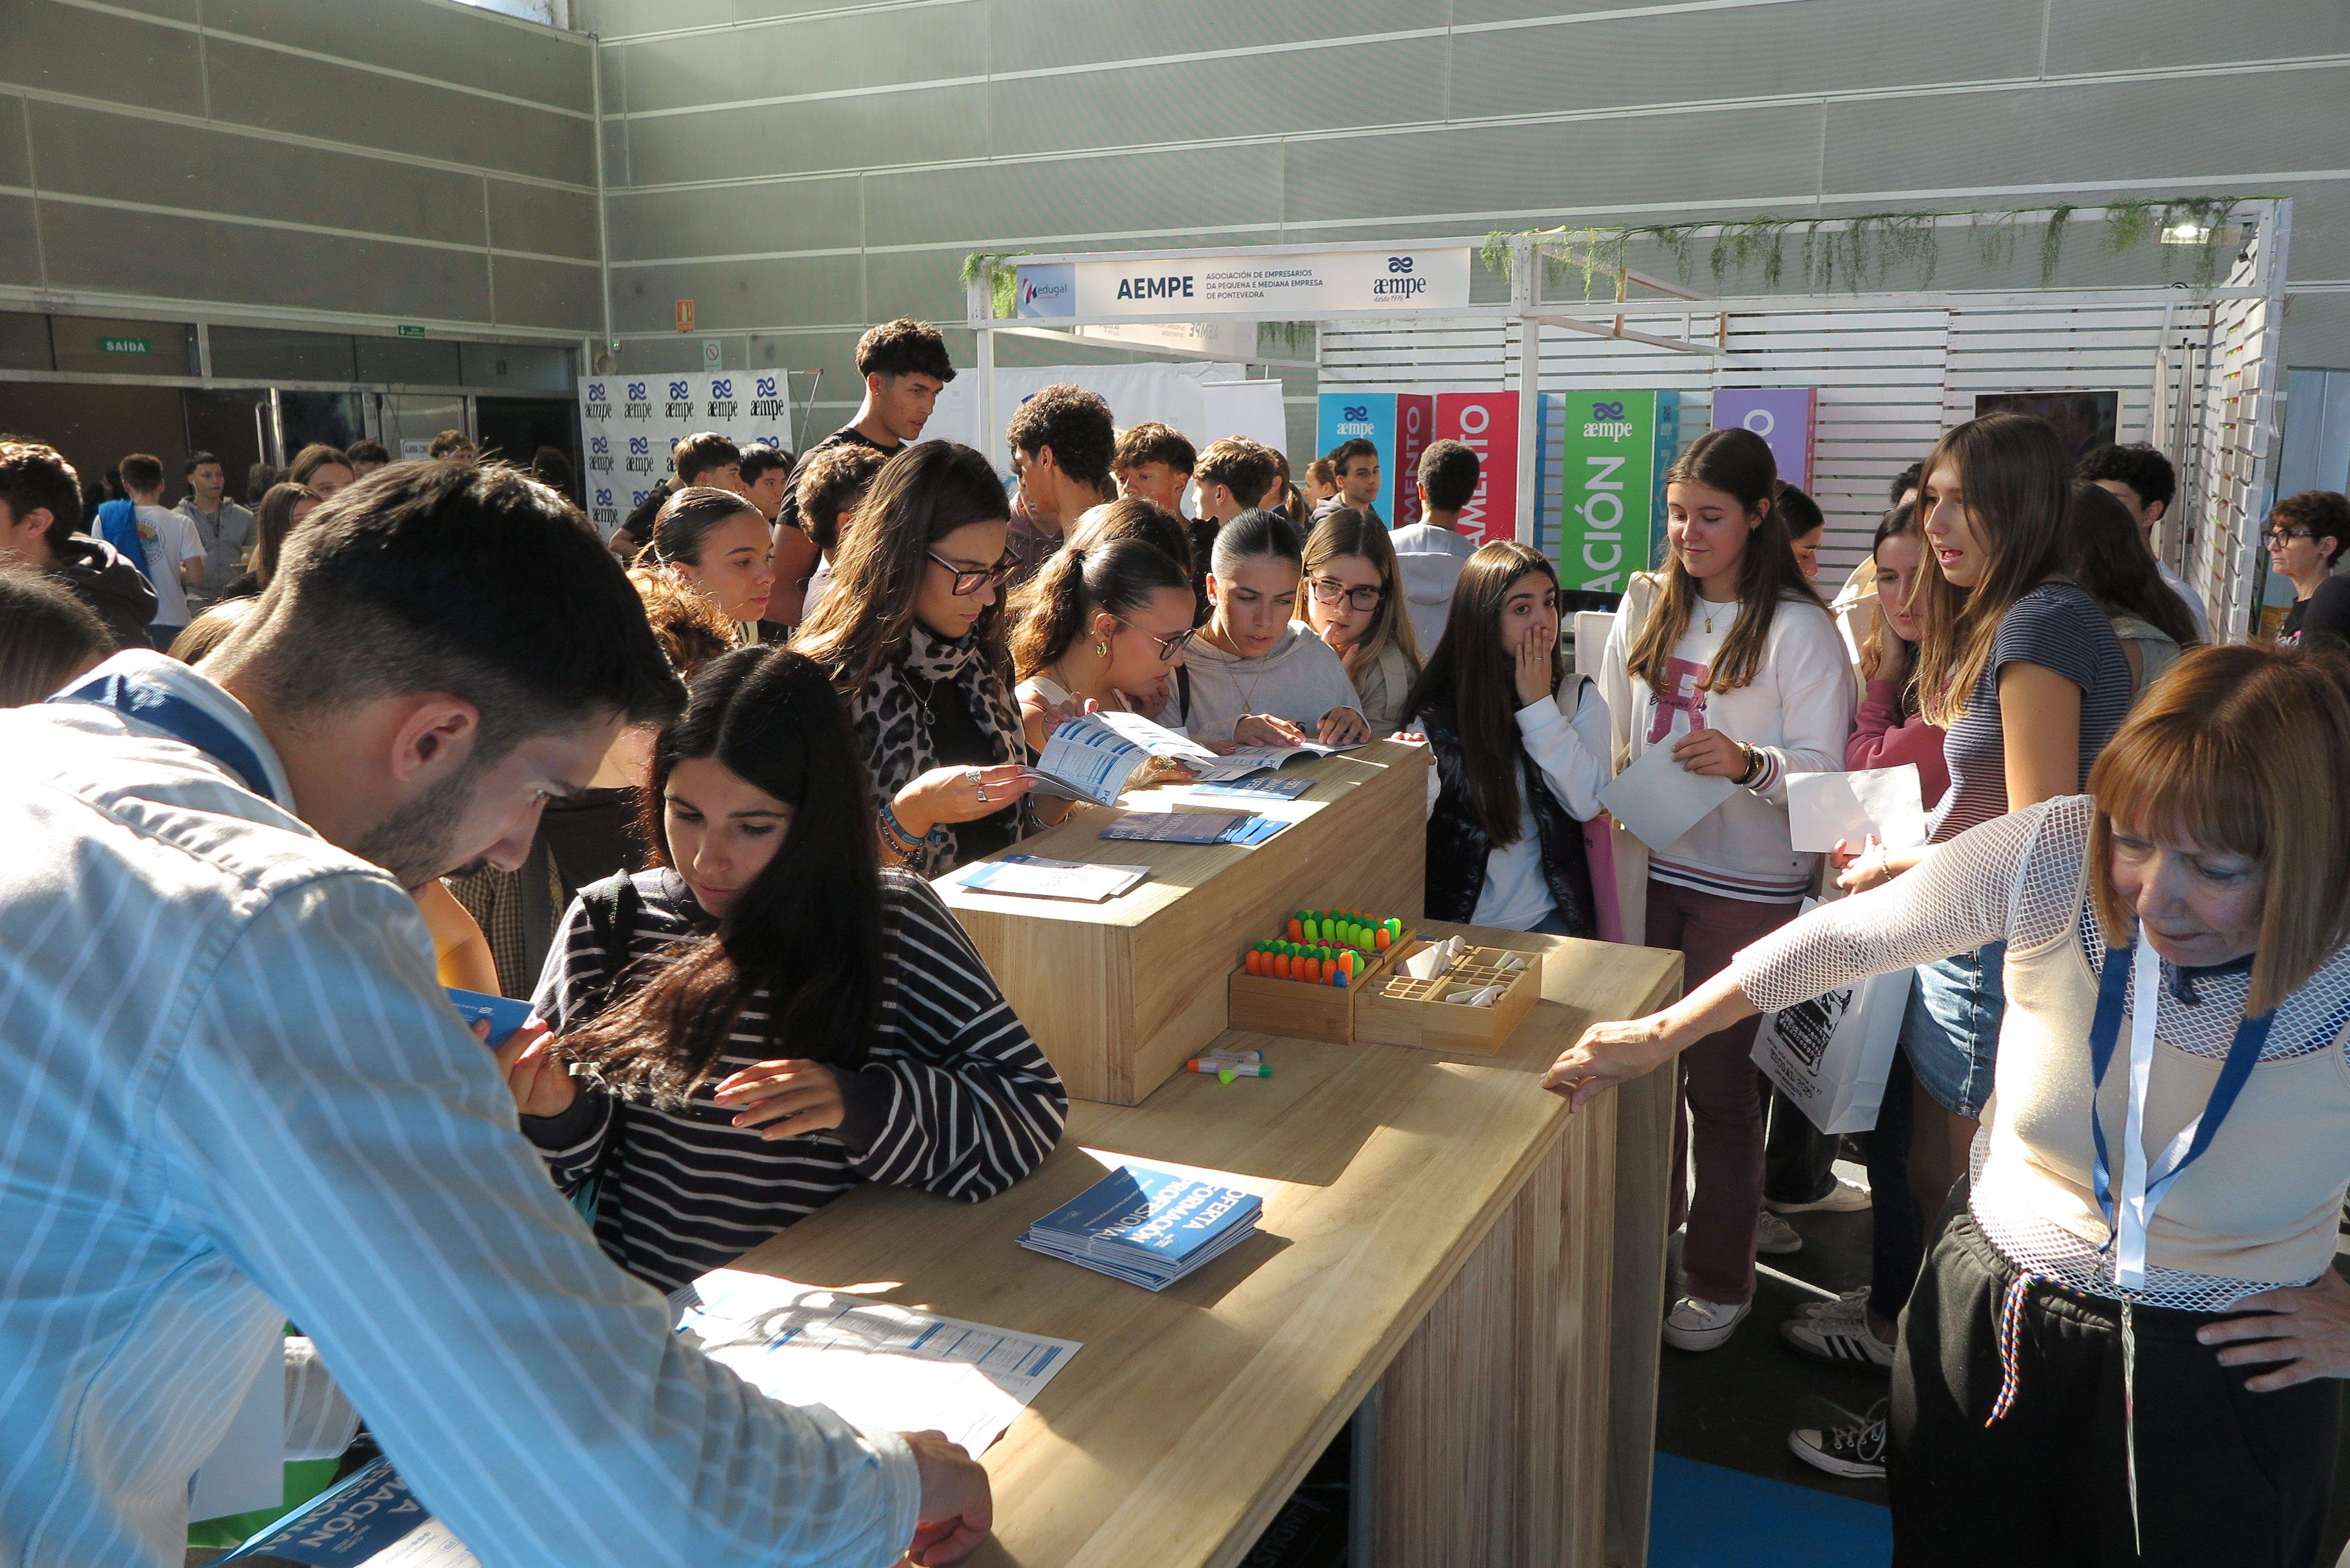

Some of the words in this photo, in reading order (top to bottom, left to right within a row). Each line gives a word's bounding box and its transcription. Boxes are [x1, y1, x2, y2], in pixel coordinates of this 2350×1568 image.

[1206, 271, 1251, 280] ASOCIACIÓN
[1265, 269, 1312, 278] EMPRESARIOS
[1037, 283, 1067, 296] edugal
[1117, 276, 1193, 299] AEMPE
[1126, 1182, 1223, 1243] FORMACIÓN
[1181, 1189, 1247, 1229] OFERTA
